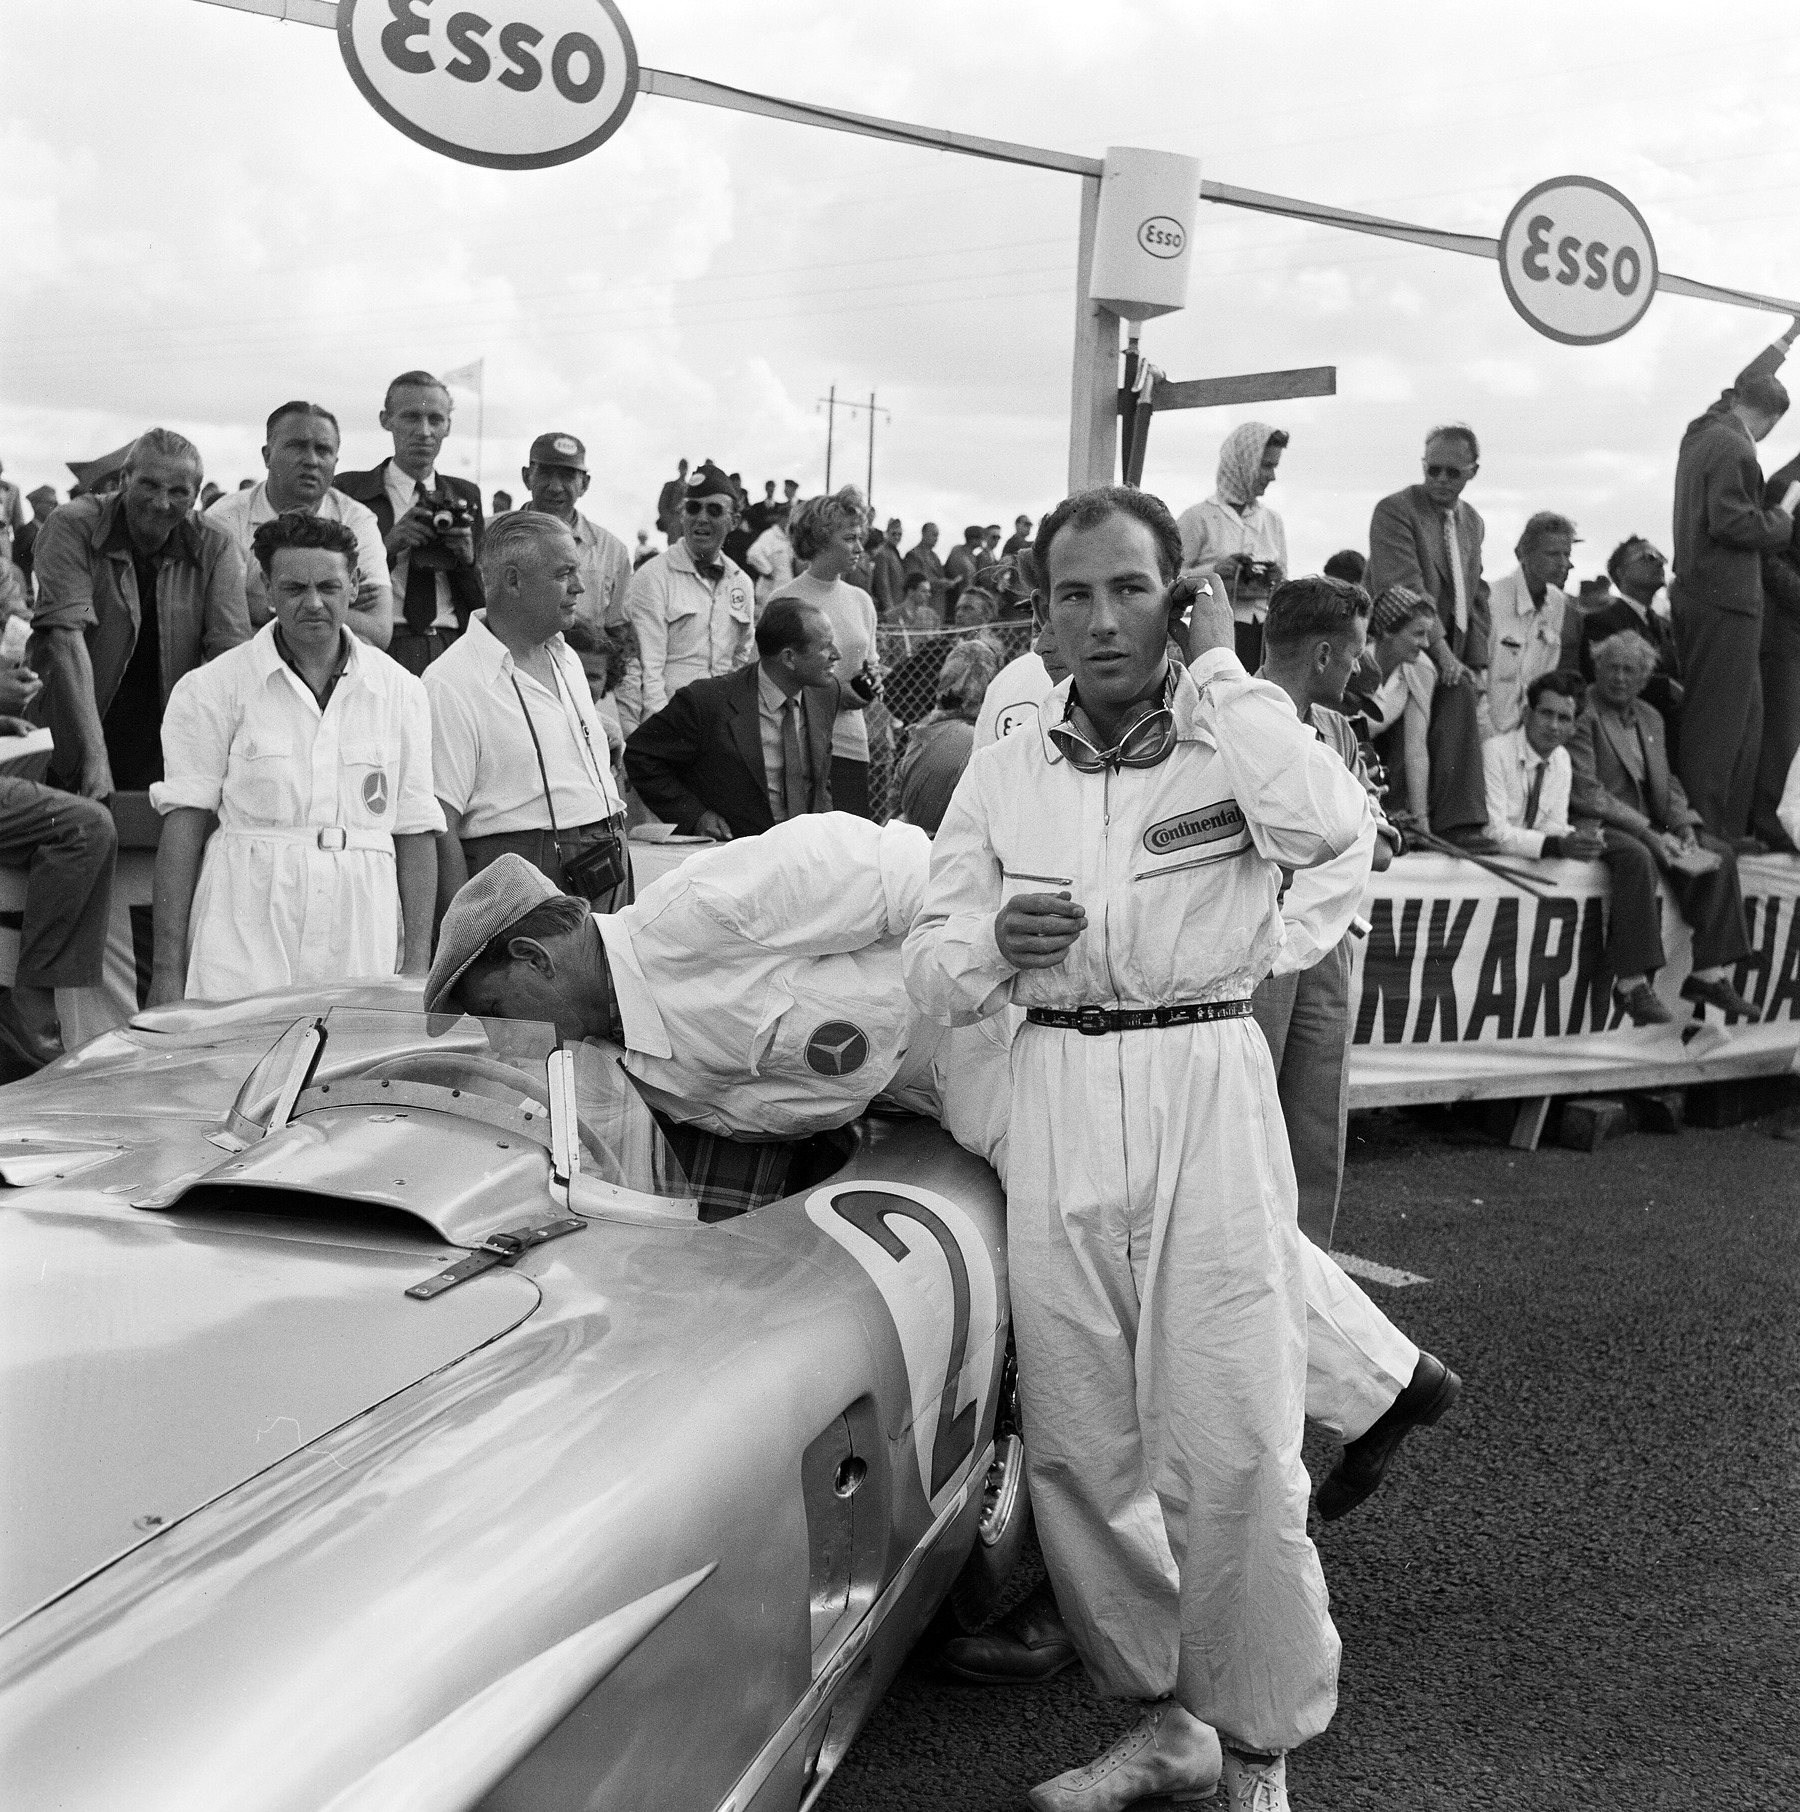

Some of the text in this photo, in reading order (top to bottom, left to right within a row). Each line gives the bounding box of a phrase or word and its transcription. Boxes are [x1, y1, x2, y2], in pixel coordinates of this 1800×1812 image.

[1522, 215, 1641, 296] Esso
[1151, 805, 1242, 848] Continental
[1352, 896, 1663, 1044] NKARN
[830, 1190, 978, 1503] 2
